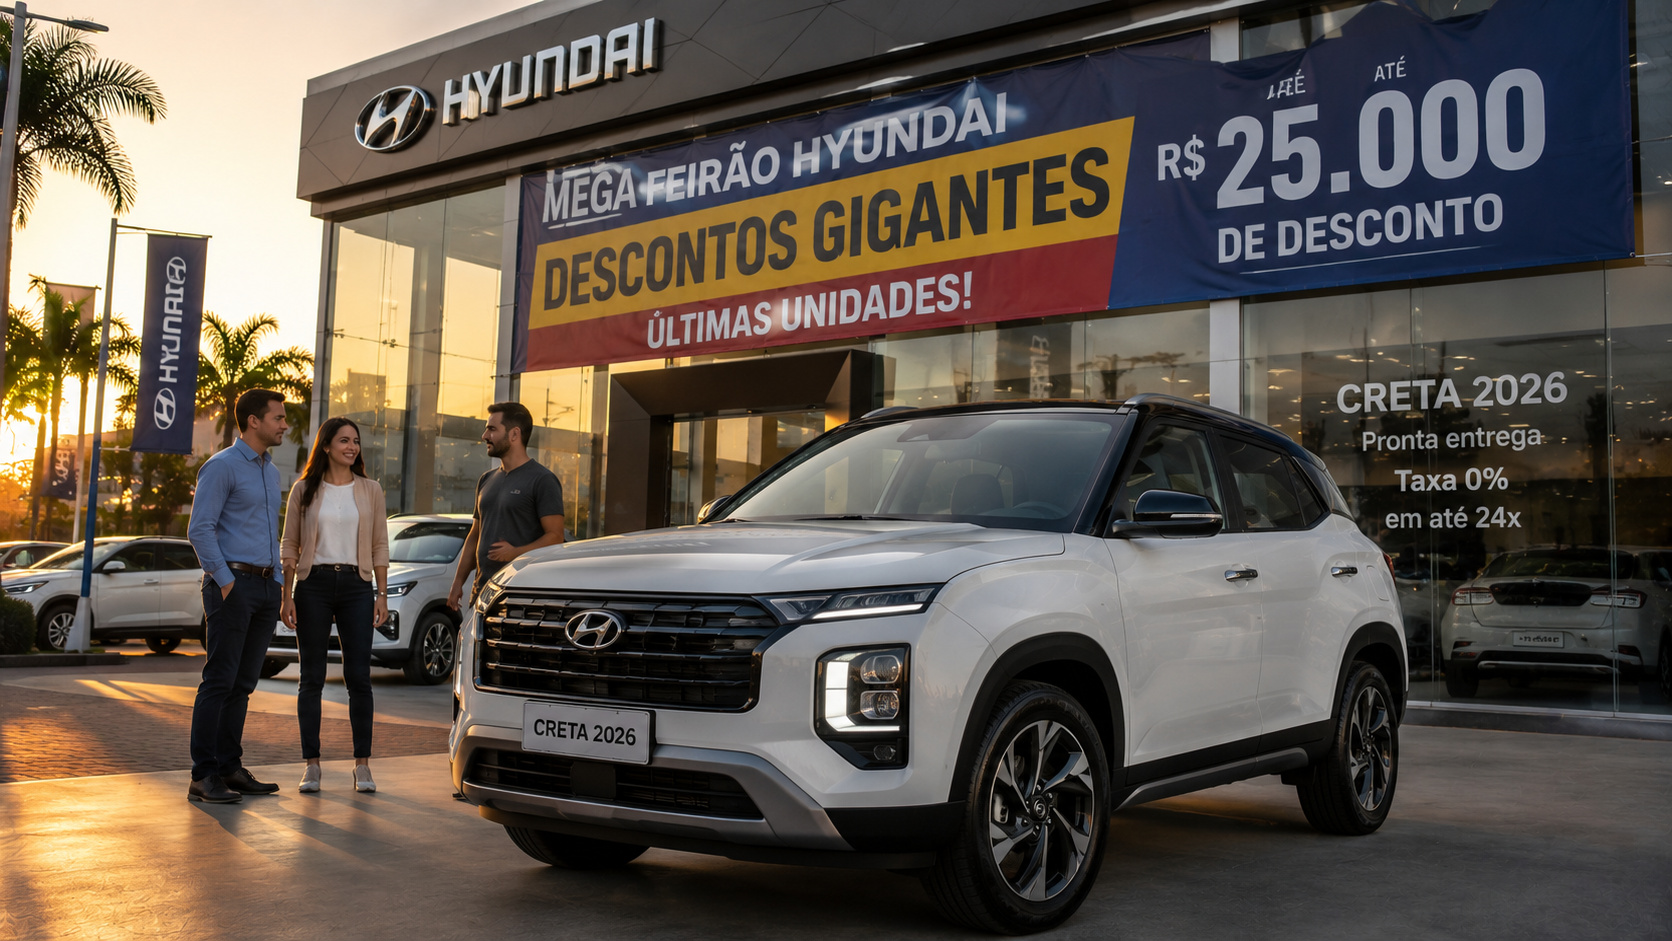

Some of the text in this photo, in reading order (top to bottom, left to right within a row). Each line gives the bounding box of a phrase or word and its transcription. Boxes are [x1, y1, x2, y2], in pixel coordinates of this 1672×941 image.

[442, 17, 658, 126] HYUNDAI
[1374, 56, 1407, 82] ATÉ
[542, 92, 1008, 223] MEGA FEIRÃO HYUNDAI
[1157, 68, 1546, 209] R$ 25.000
[543, 147, 1110, 311] DESCONTOS GIGANTES
[1218, 193, 1504, 264] DE DESCONTO
[647, 271, 973, 350] ÚLTIMAS UNIDADES!
[1336, 371, 1568, 414] CRETA 2026
[1362, 427, 1542, 451] Pronta entrega
[1394, 467, 1509, 492] Taxa 0%
[1385, 506, 1522, 529] em até 24x
[533, 717, 637, 746] CRETA 2026
